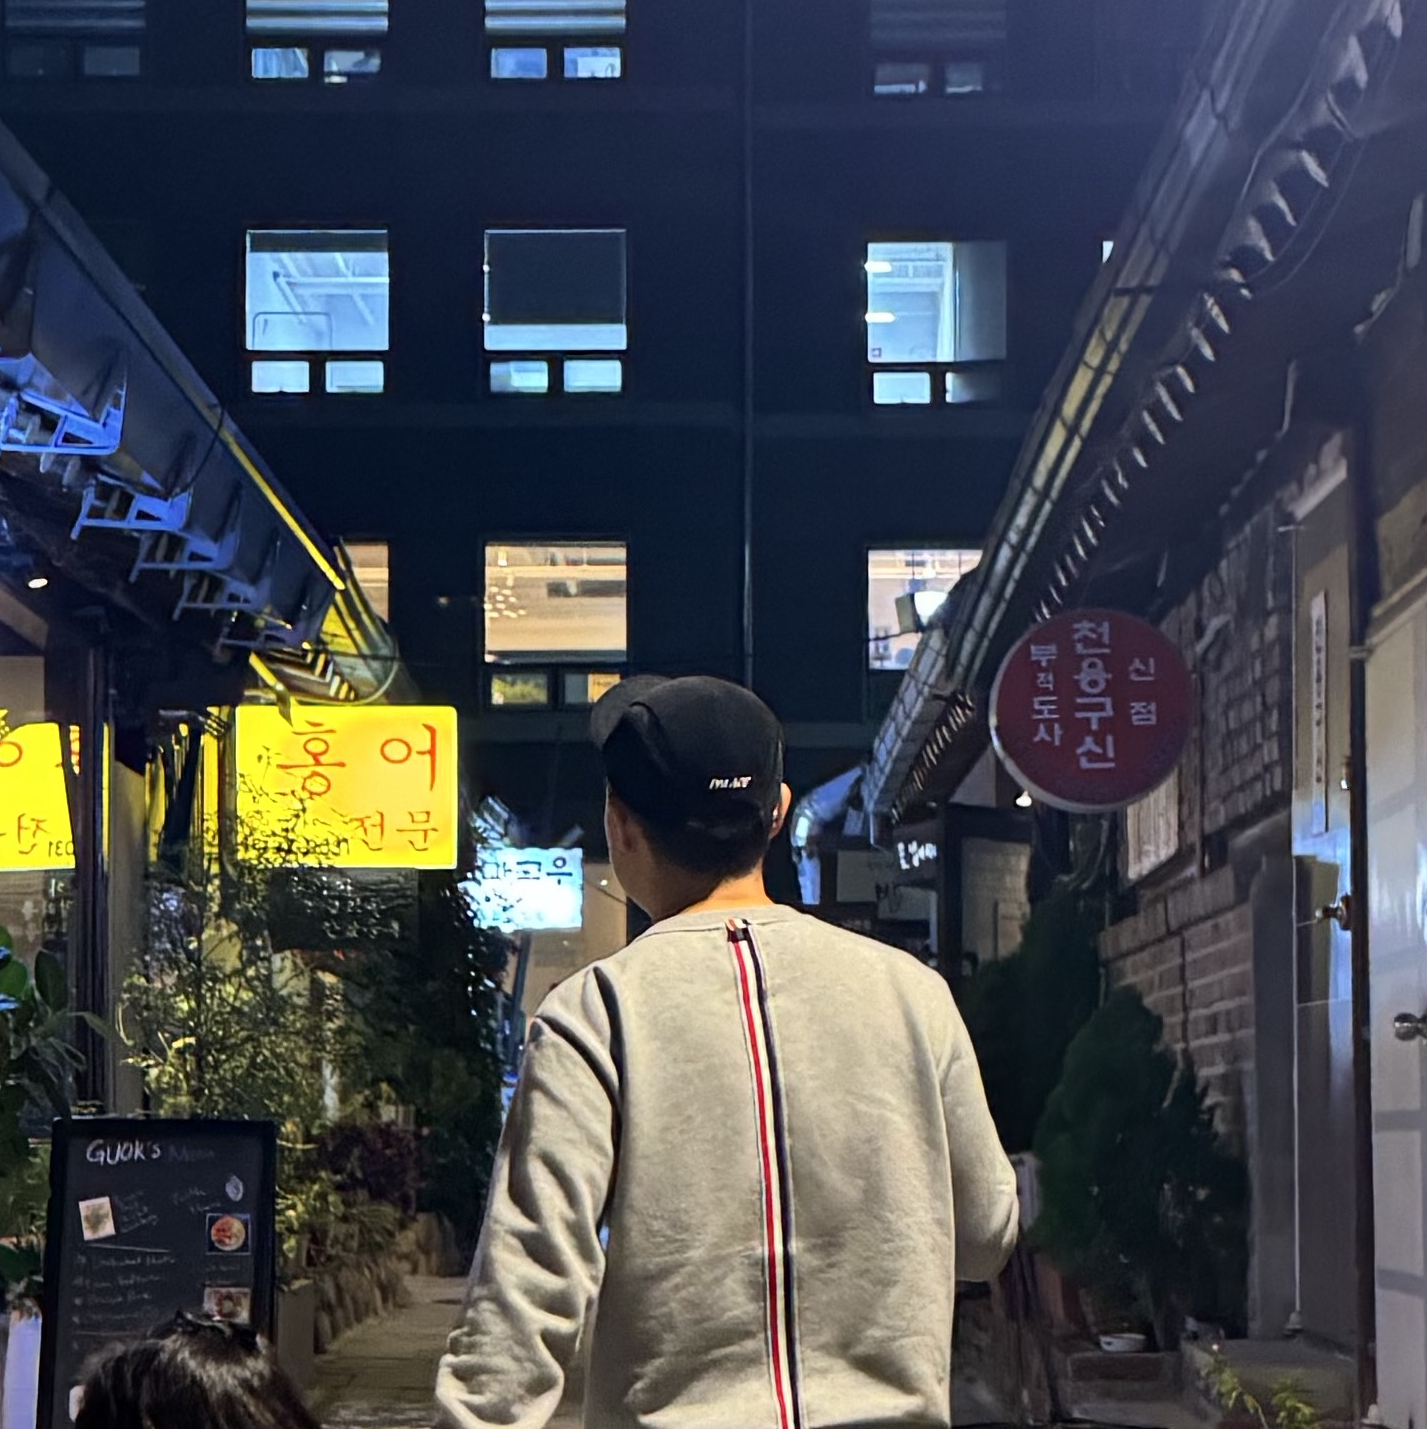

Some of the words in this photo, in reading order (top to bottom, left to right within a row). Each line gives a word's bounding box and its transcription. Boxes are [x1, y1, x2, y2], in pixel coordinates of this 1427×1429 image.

[1029, 644, 1063, 747] 부적도사
[1073, 619, 1116, 770] 천용구신
[1129, 656, 1158, 726] 신점
[275, 719, 439, 797] 홍어
[348, 809, 440, 853] 전문
